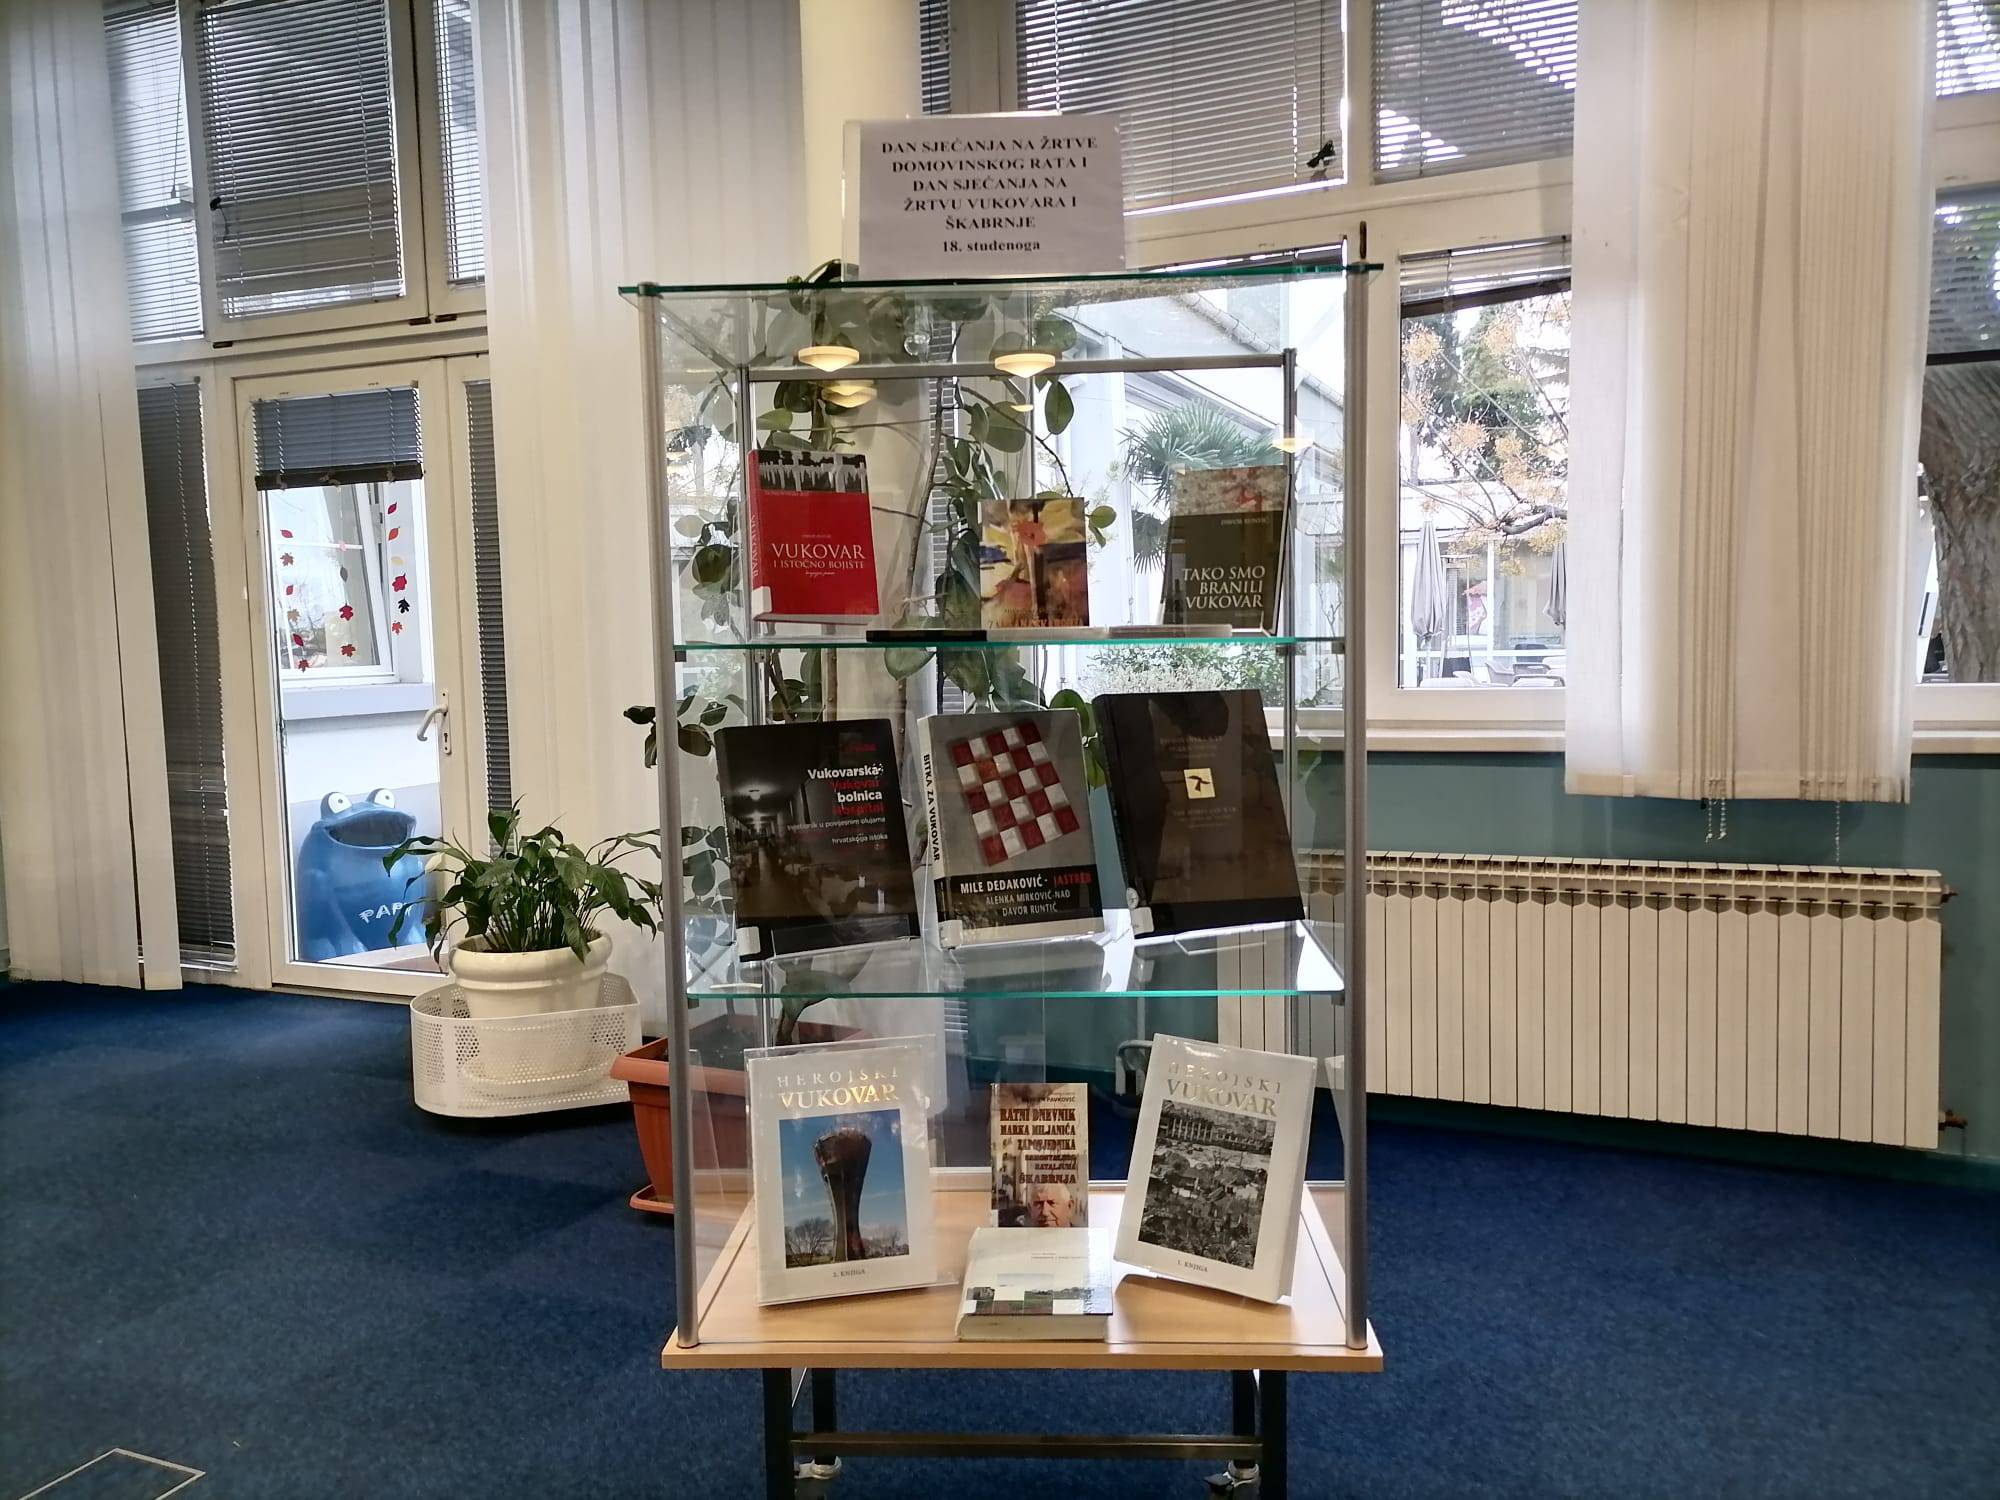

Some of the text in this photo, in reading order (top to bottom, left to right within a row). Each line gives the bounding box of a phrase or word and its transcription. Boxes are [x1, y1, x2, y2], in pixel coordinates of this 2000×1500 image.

[882, 135, 1098, 153] DAN SJEĆANJA NA ŽRTVE
[892, 156, 1087, 173] DOMOVINSKOG RATA I
[913, 175, 1067, 192] DAN SJEĆANJA NA
[904, 195, 1077, 212] ŽRTVU VUKOVARA I
[945, 215, 1036, 230] ŠKABRNJE
[943, 240, 1040, 252] 18. studenoga
[771, 543, 866, 560] VUKOVAR
[780, 559, 826, 569] ISTOČNO
[1182, 565, 1266, 581] TAKO SMO
[1200, 580, 1263, 595] BRANILI
[1186, 594, 1264, 609] VUKOVAR
[808, 765, 880, 779] Vukovarska
[837, 790, 883, 803] bolnica
[923, 754, 941, 862] BITKA ZA VUKOVAR
[960, 881, 984, 894] MILE
[986, 873, 1043, 892] DEDAKOVIĆ
[985, 894, 1015, 906] ALENKA
[358, 901, 415, 924] PAP
[1002, 902, 1059, 917] DAVOR RUNTIĆ
[777, 1067, 898, 1088] HEROJSKI
[1168, 1062, 1281, 1094] HEROJSKI
[778, 1084, 899, 1109] VUKOVAR
[1167, 1078, 1277, 1117] VUKOVAR
[1000, 1108, 1076, 1121] RATNI DNEVNIK
[1000, 1122, 1076, 1135] MARKA MILJANIĆA
[1019, 1172, 1076, 1184] ŠKABRNJA
